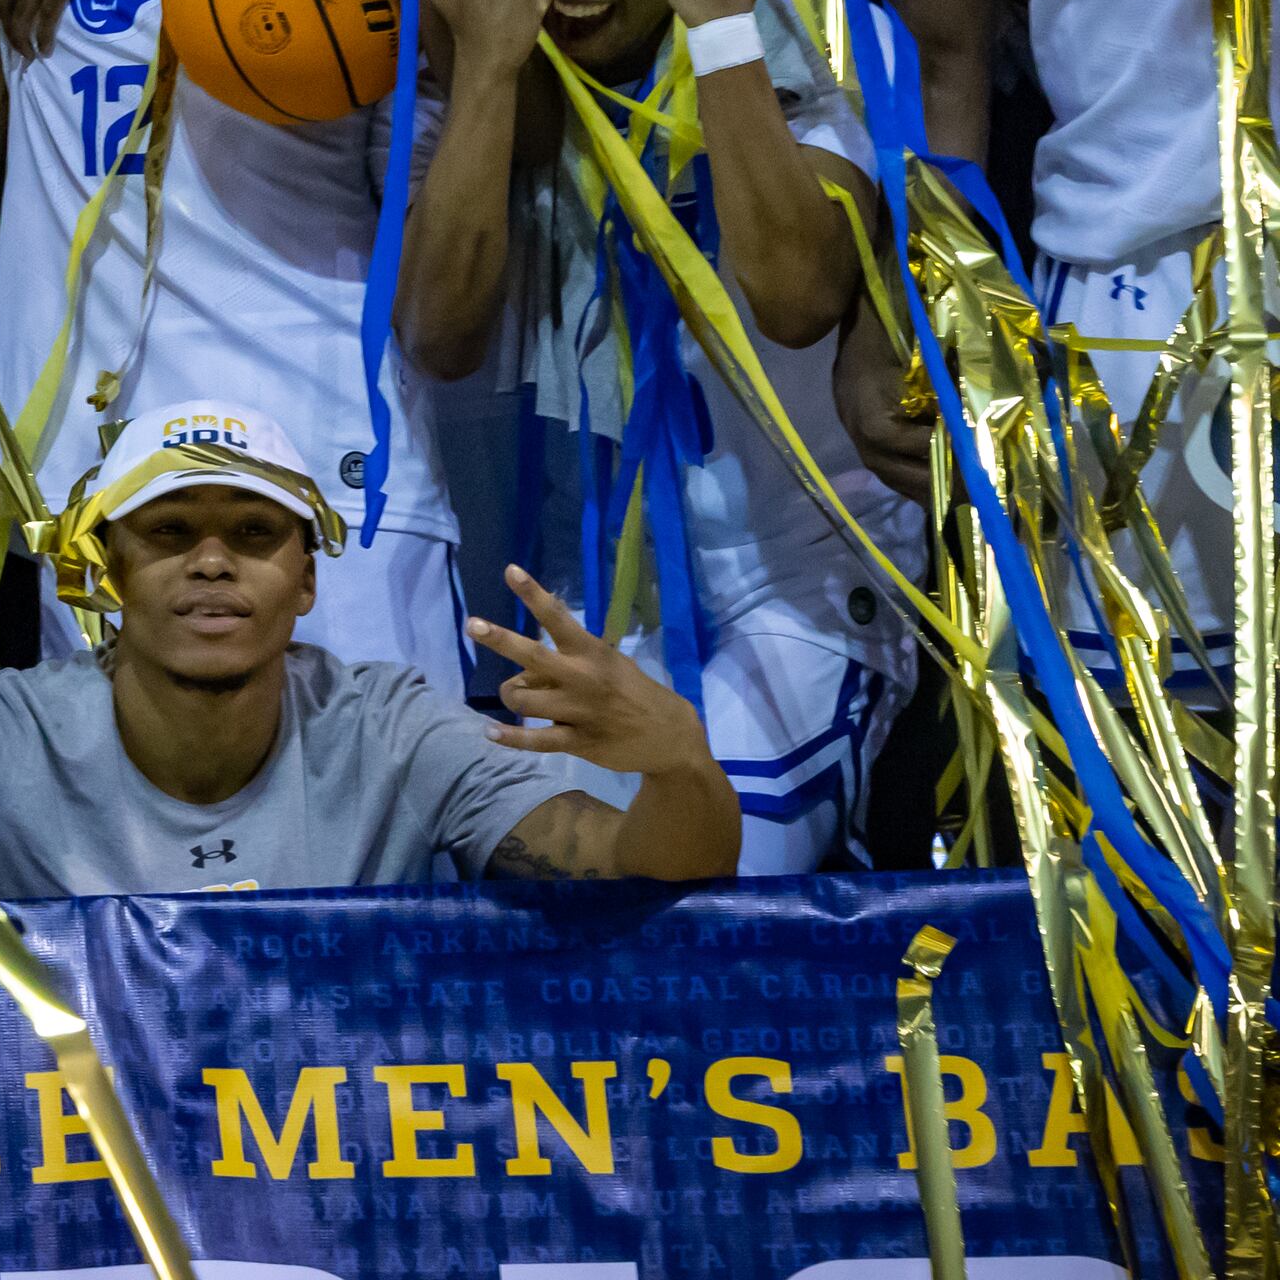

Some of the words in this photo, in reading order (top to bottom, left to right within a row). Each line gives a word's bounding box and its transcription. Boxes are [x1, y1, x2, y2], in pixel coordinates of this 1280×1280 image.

[70, 64, 151, 178] 12
[162, 414, 248, 449] SBC
[540, 975, 740, 1005] COASTAL
[201, 1055, 804, 1181] MEN'S
